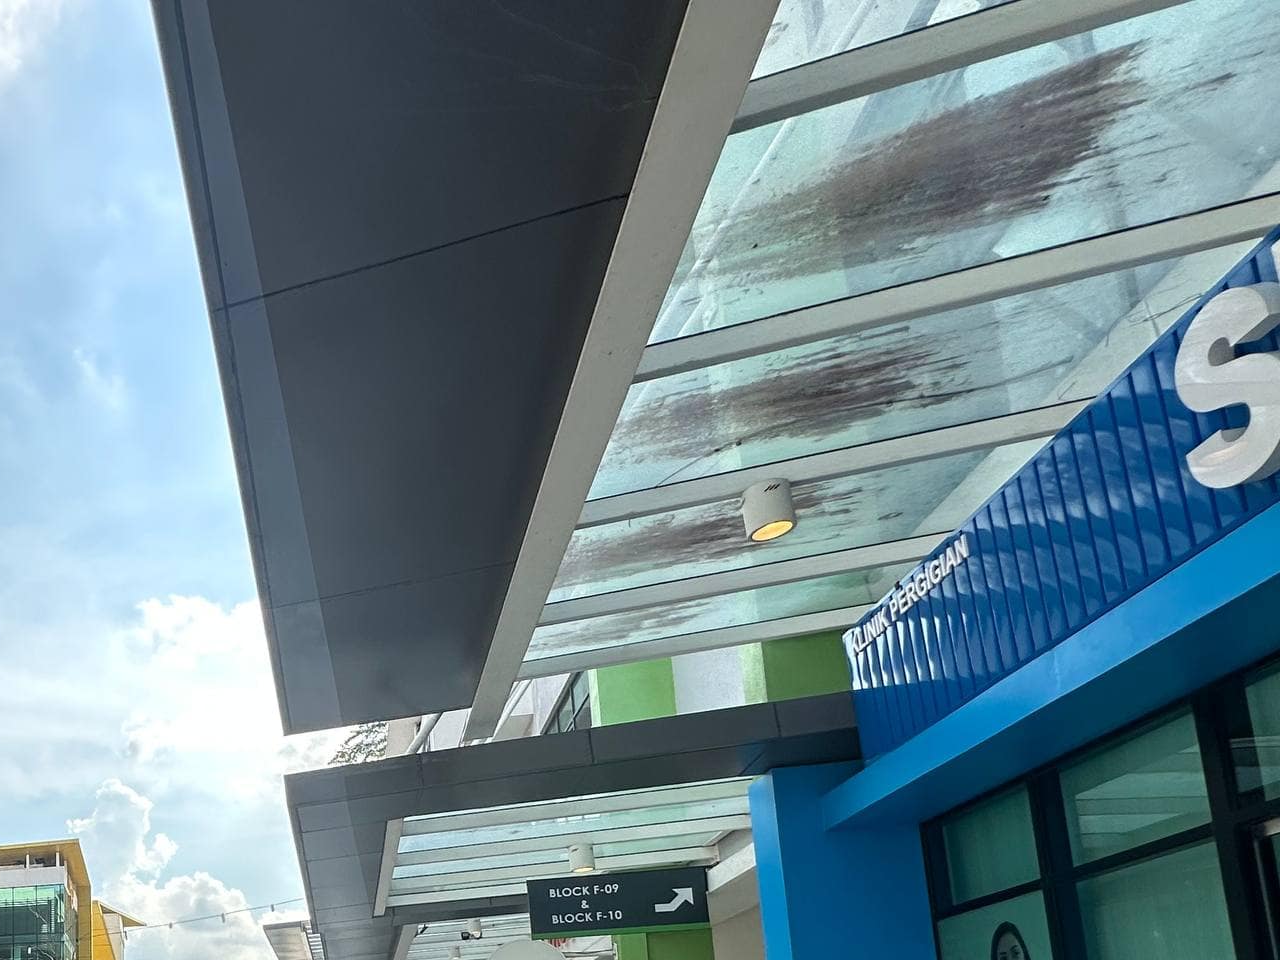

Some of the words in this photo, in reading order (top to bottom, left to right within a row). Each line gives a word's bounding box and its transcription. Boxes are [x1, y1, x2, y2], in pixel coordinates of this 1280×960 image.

[1175, 245, 1280, 489] S
[852, 606, 890, 655] KLINIK
[889, 534, 969, 622] PERGIGIAN
[549, 886, 590, 898] BLOCK
[593, 883, 620, 895] F-09
[580, 900, 589, 909] &
[552, 912, 593, 925] BLOCK
[596, 910, 623, 921] F-10
